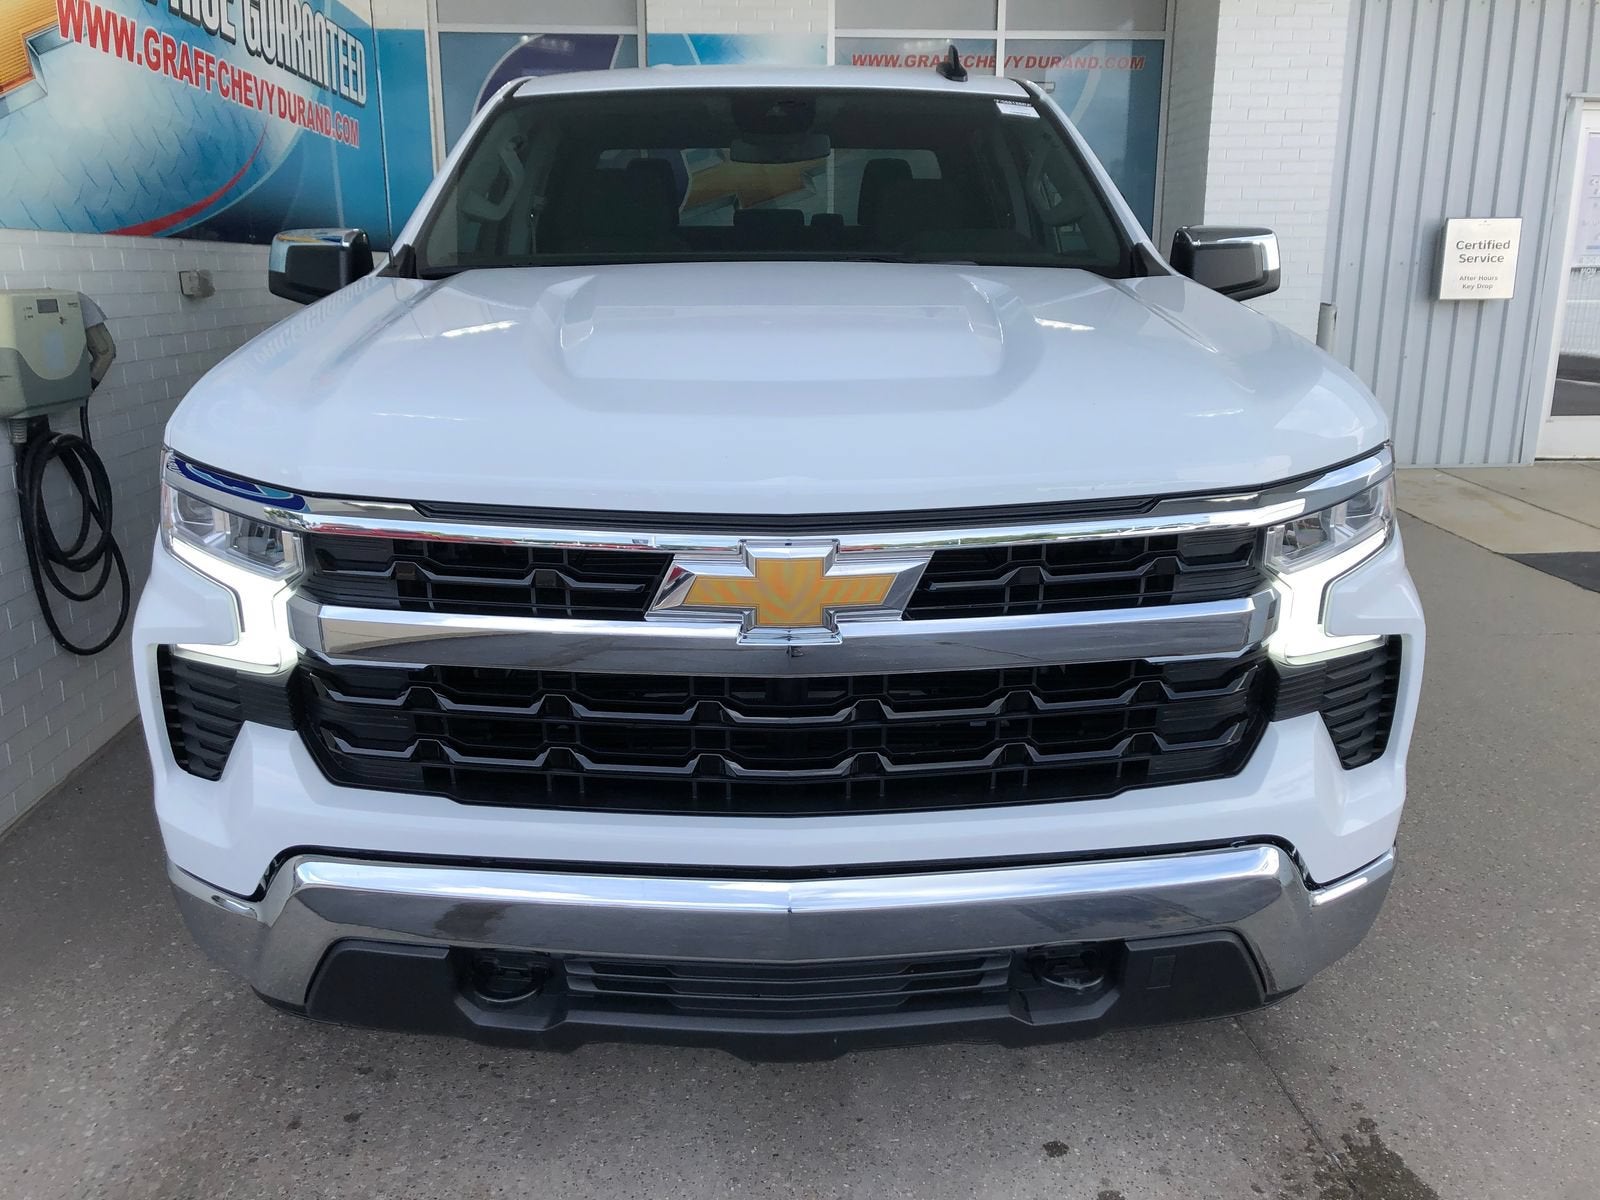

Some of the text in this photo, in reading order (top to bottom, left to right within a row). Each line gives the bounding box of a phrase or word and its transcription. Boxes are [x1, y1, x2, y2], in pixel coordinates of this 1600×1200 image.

[56, 0, 360, 148] WWW.GRAFFCHEVYDURAND.COM
[1456, 240, 1511, 250] Certified
[1458, 253, 1505, 264] Service
